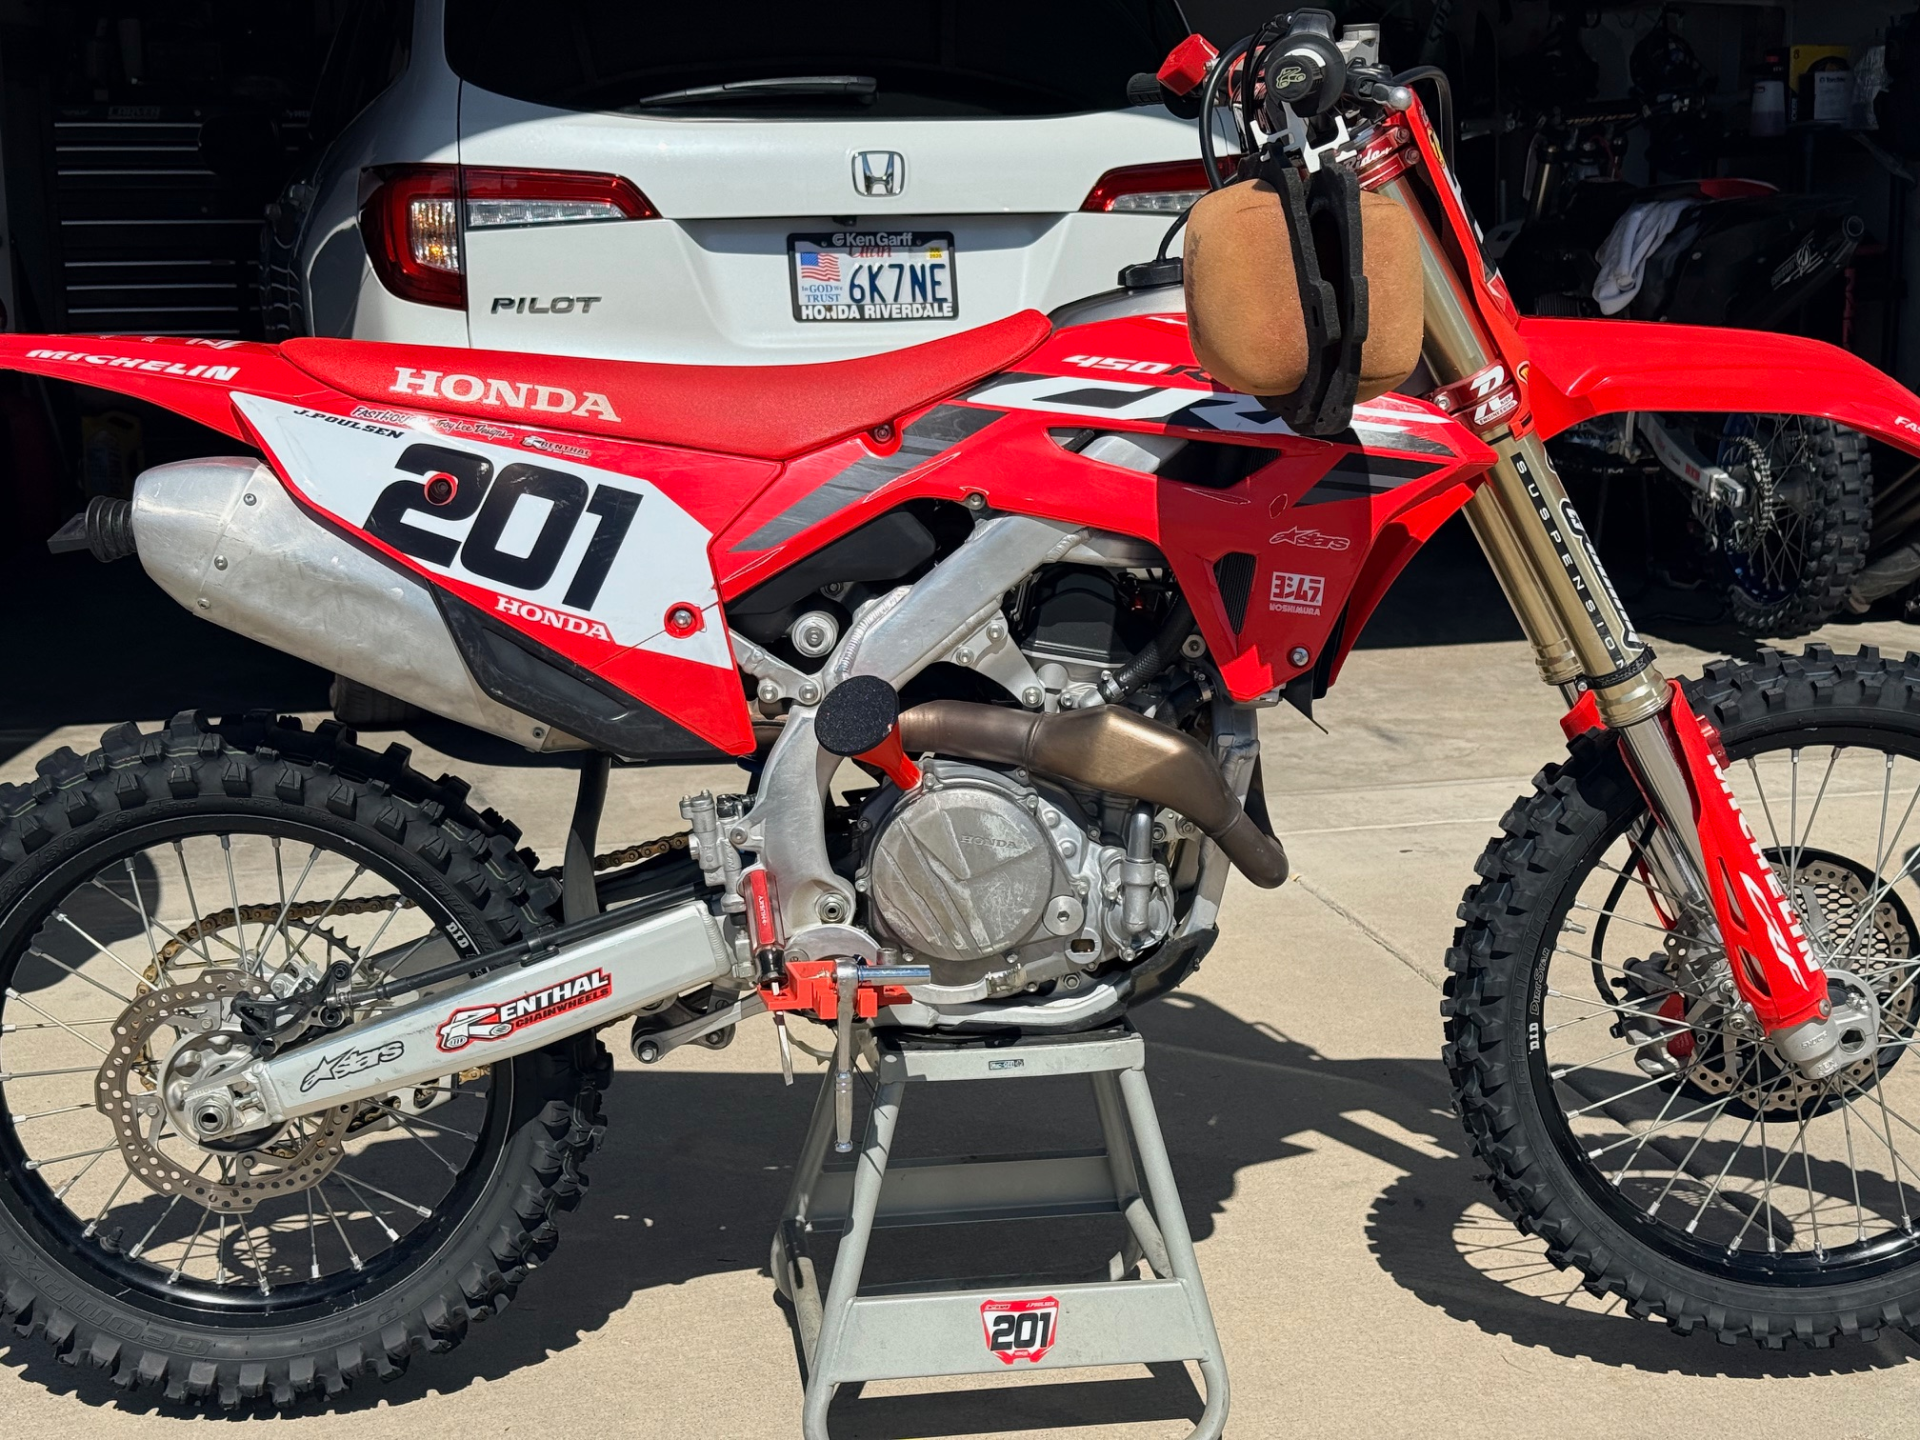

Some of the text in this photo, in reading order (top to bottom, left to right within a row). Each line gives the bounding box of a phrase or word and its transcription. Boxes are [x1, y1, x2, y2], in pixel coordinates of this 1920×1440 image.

[846, 232, 912, 246] Ken Garff
[805, 294, 842, 303] TRUST
[810, 284, 833, 293] GOD
[850, 263, 948, 304] 6K7NE
[490, 295, 603, 315] PILOT
[801, 303, 954, 320] HONDA RIVERDALE
[25, 349, 241, 382] MICHELIN
[389, 366, 622, 423] HONDA
[293, 409, 405, 439] J.POULSEN
[455, 420, 473, 433] Lee
[364, 443, 643, 611] 201
[494, 596, 612, 641] HONDA
[960, 834, 1019, 850] HONDA
[1740, 871, 1809, 992] CRF
[441, 971, 610, 1048] RENTHAL
[515, 988, 610, 1028] CHAINWHEELS
[990, 1312, 1051, 1351] 201
